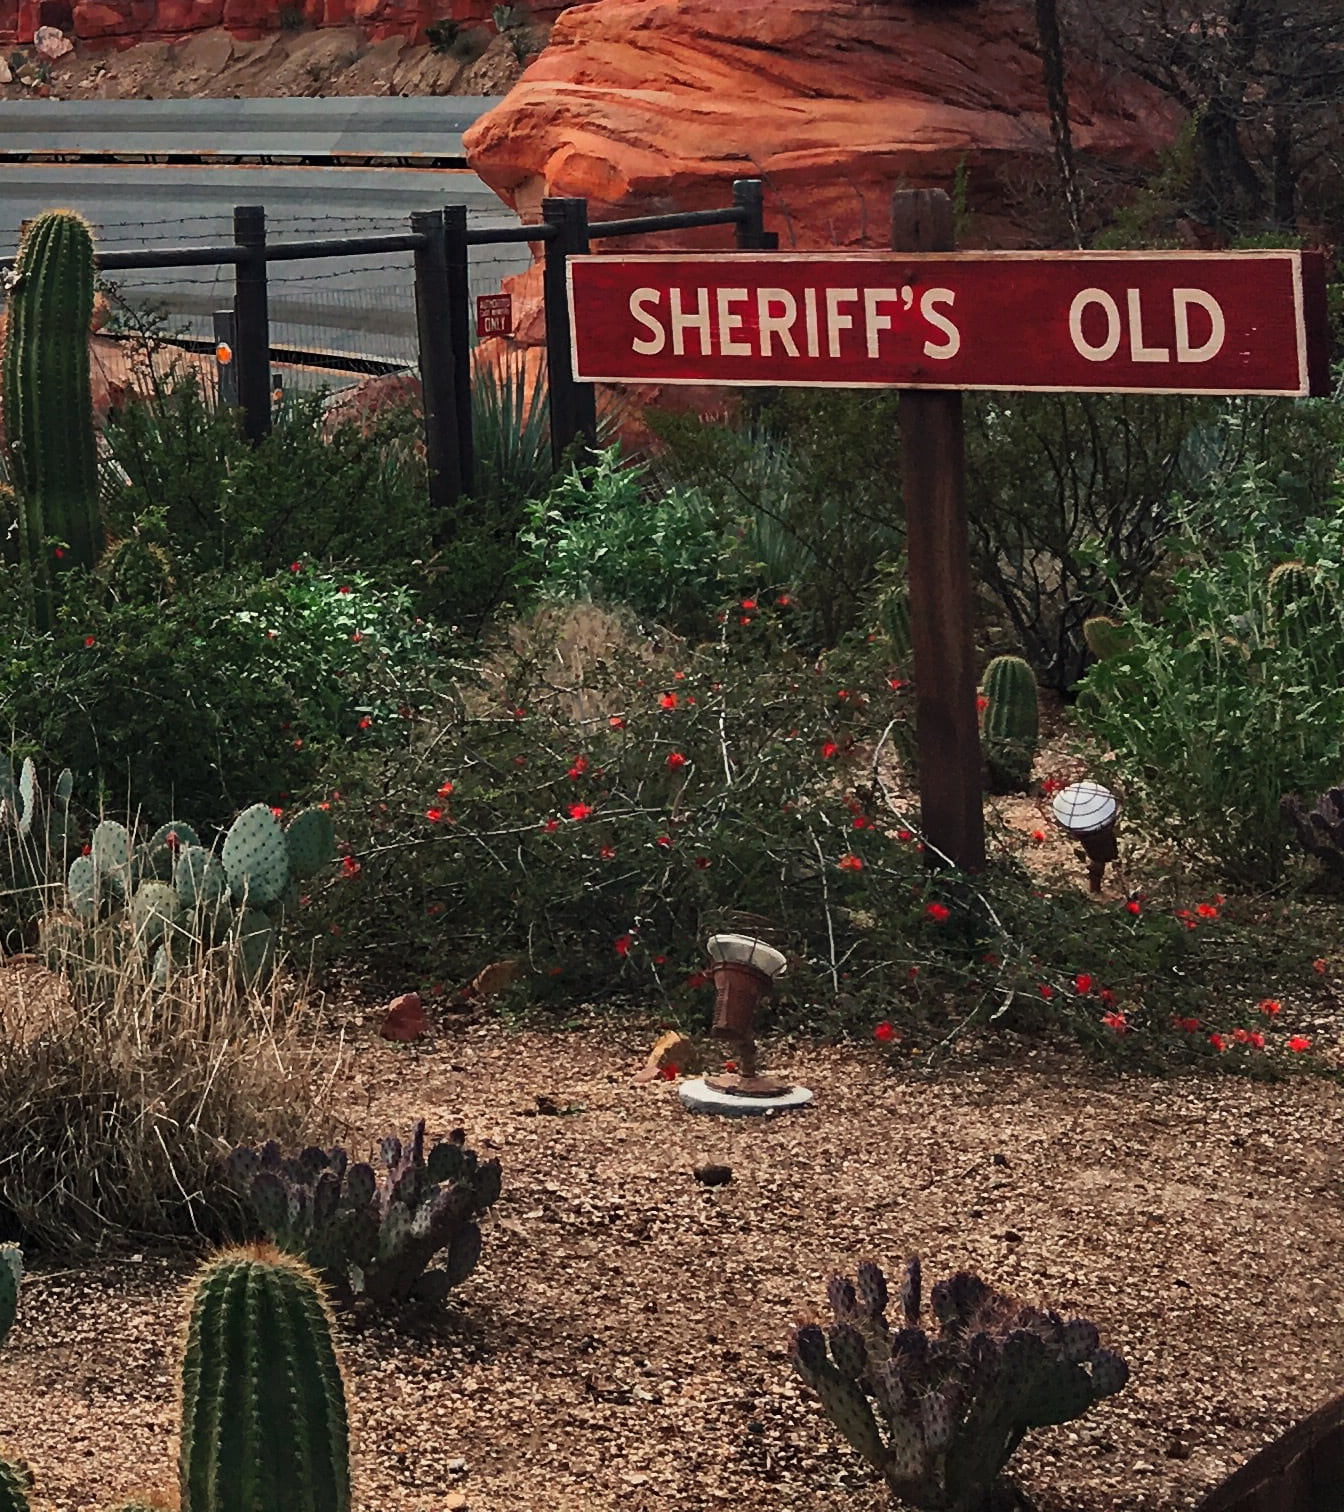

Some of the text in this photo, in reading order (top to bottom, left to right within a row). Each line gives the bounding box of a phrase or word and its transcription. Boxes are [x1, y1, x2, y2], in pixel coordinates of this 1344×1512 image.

[484, 317, 505, 332] ONLY
[629, 285, 1225, 363] SHERIFF'S OLD
